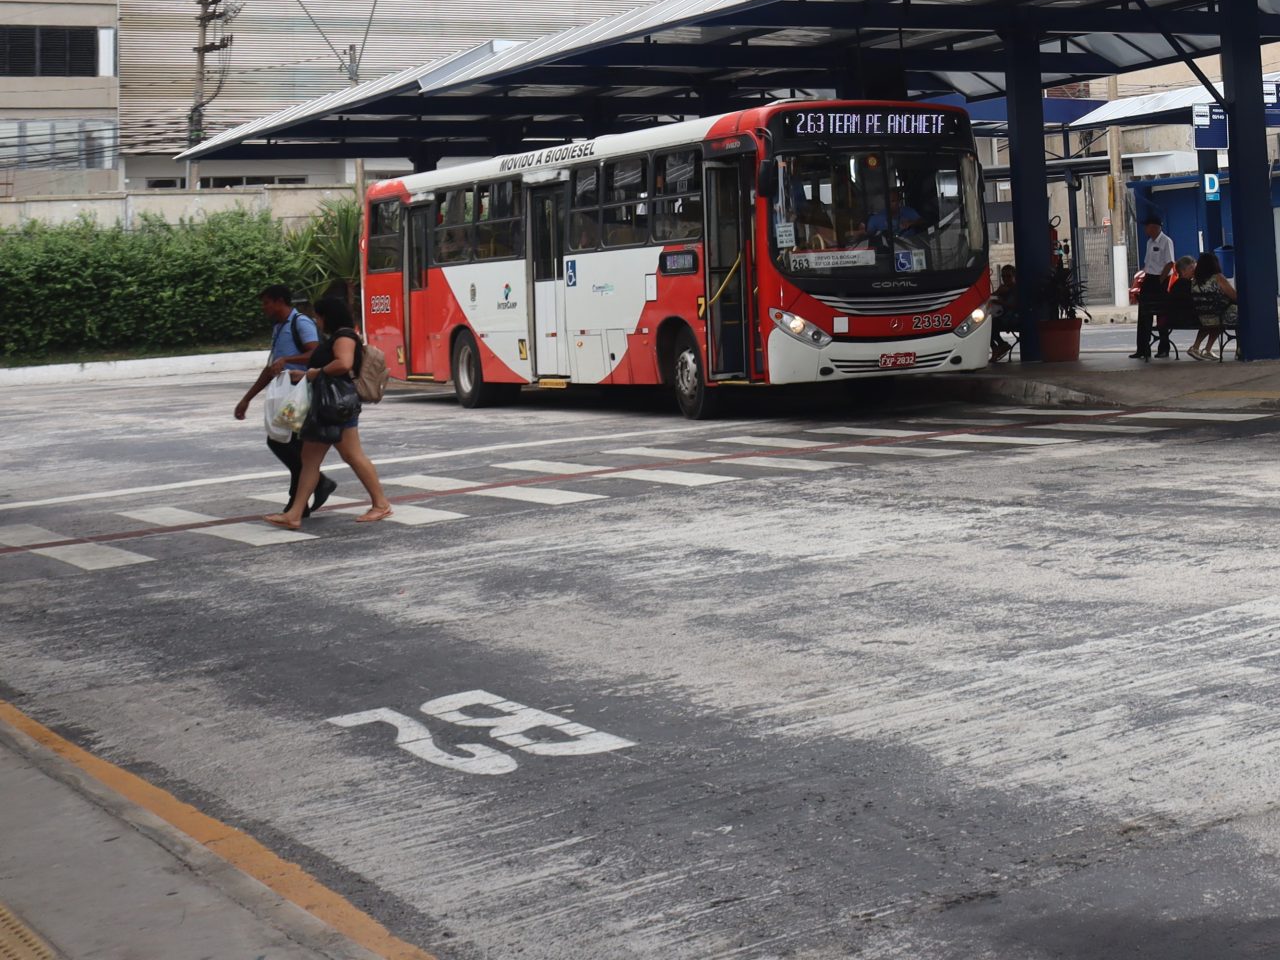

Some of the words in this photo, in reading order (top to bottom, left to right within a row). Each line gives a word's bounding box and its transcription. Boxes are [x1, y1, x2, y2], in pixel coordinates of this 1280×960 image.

[499, 154, 534, 172] MOVIDO
[535, 152, 543, 165] A
[544, 142, 595, 165] BIODIESEL
[1204, 173, 1219, 193] D
[791, 258, 810, 270] 263
[912, 314, 952, 330] 2332
[325, 689, 641, 775] B2
